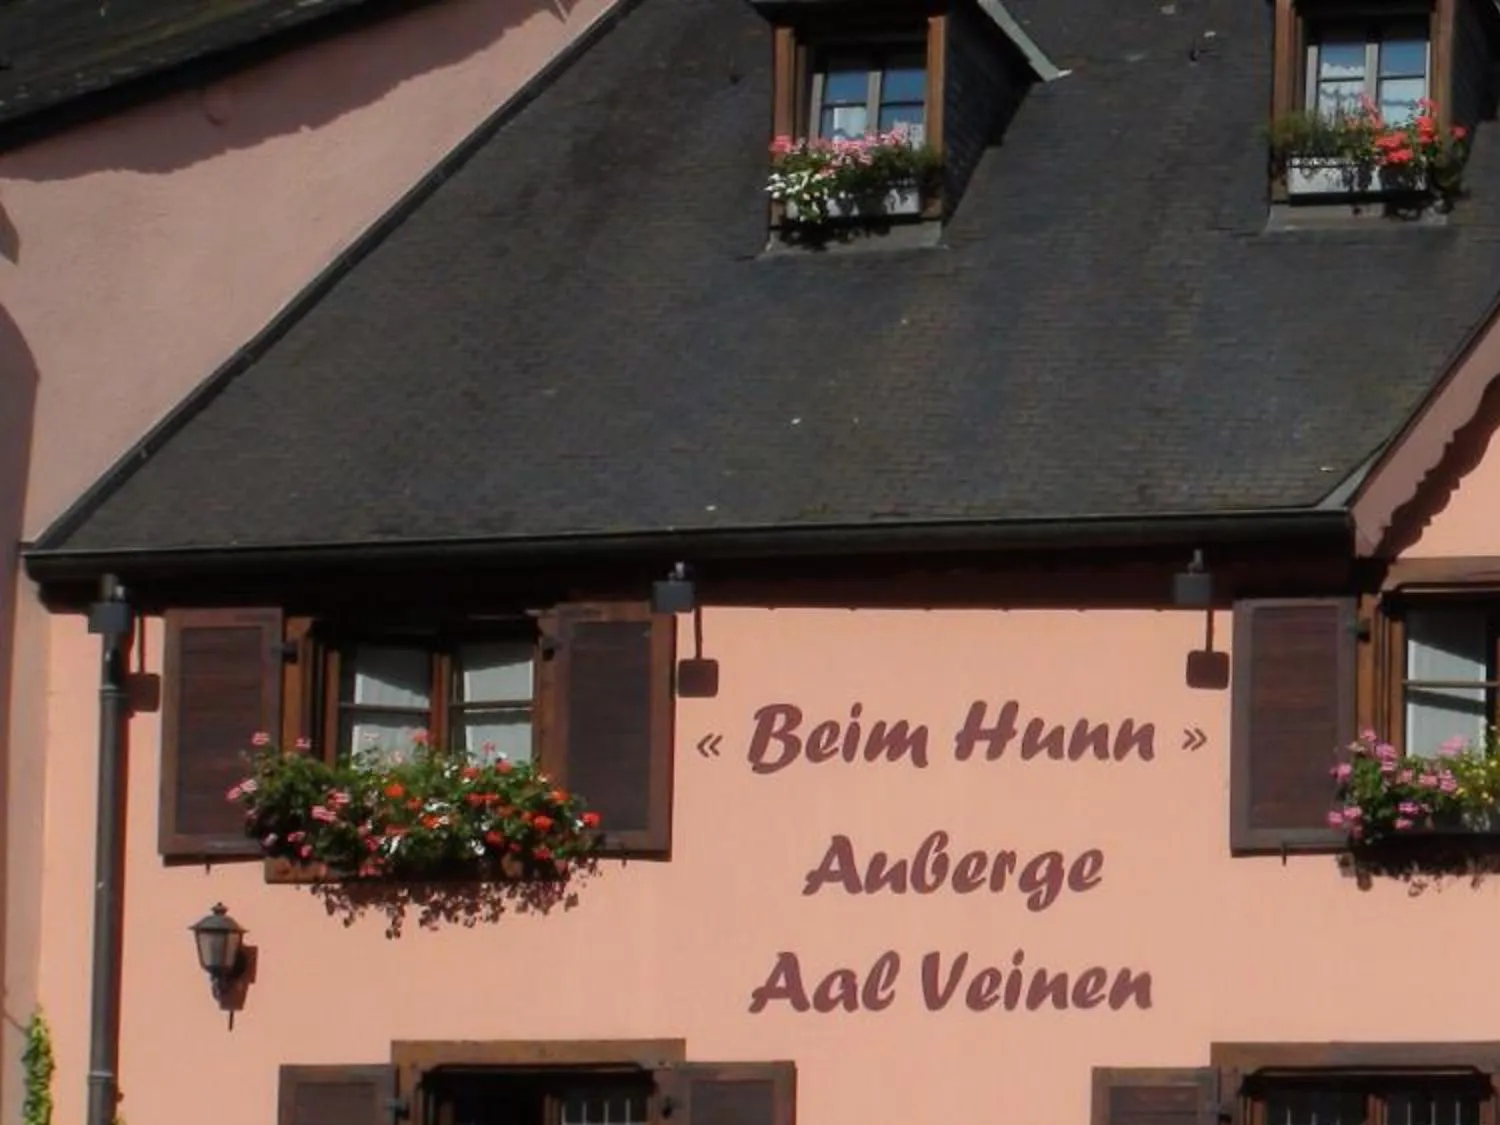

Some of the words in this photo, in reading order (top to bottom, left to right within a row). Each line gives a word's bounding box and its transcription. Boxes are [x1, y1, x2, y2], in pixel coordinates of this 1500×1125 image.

[747, 701, 929, 775] Beim
[954, 699, 1156, 762] Hunn
[801, 830, 1105, 913] Auberge
[748, 949, 901, 1014] Aal
[921, 948, 1153, 1012] Veinen
